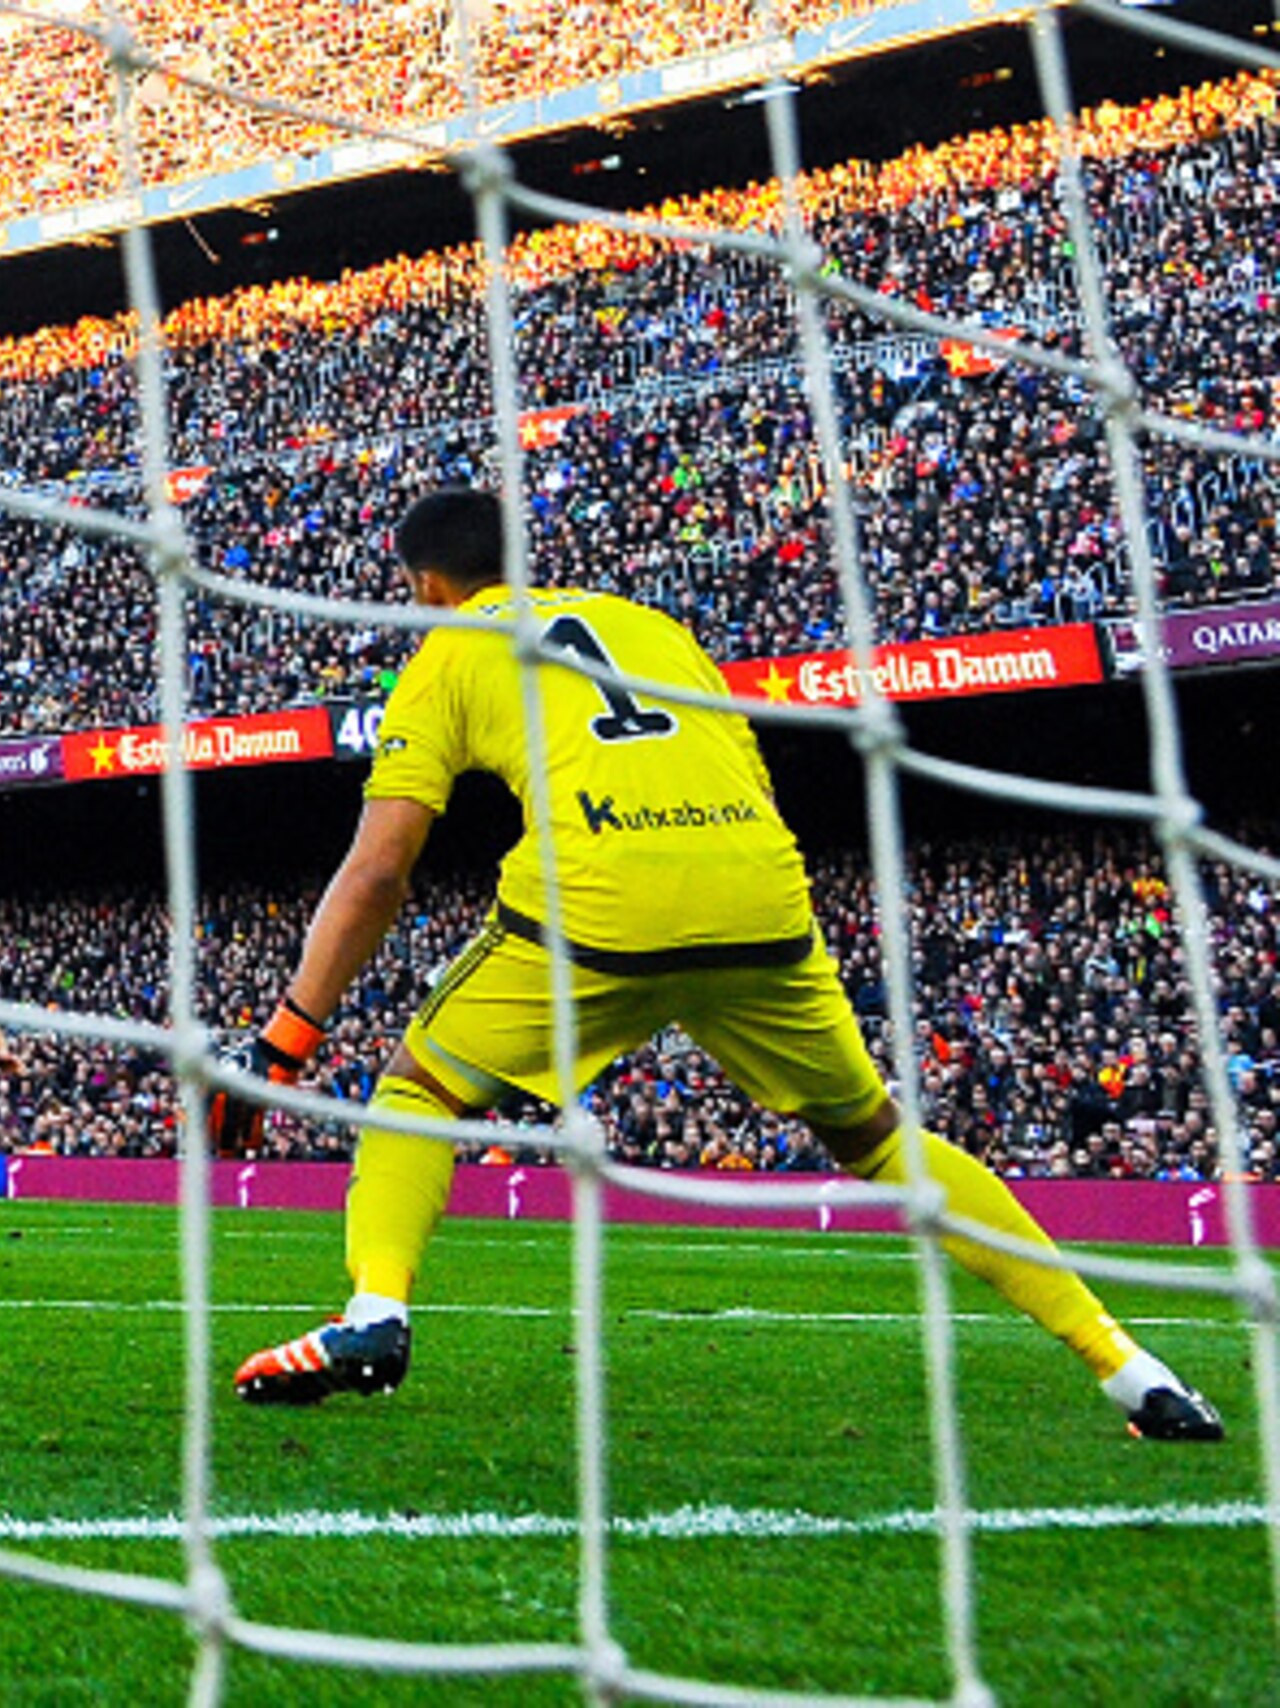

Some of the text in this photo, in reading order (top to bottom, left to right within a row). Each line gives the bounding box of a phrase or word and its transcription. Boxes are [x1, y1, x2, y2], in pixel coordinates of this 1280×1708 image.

[1192, 617, 1280, 655] QATAR
[540, 614, 678, 744] 1
[931, 648, 1057, 690] Damm
[120, 723, 301, 771] Estrlla Damm
